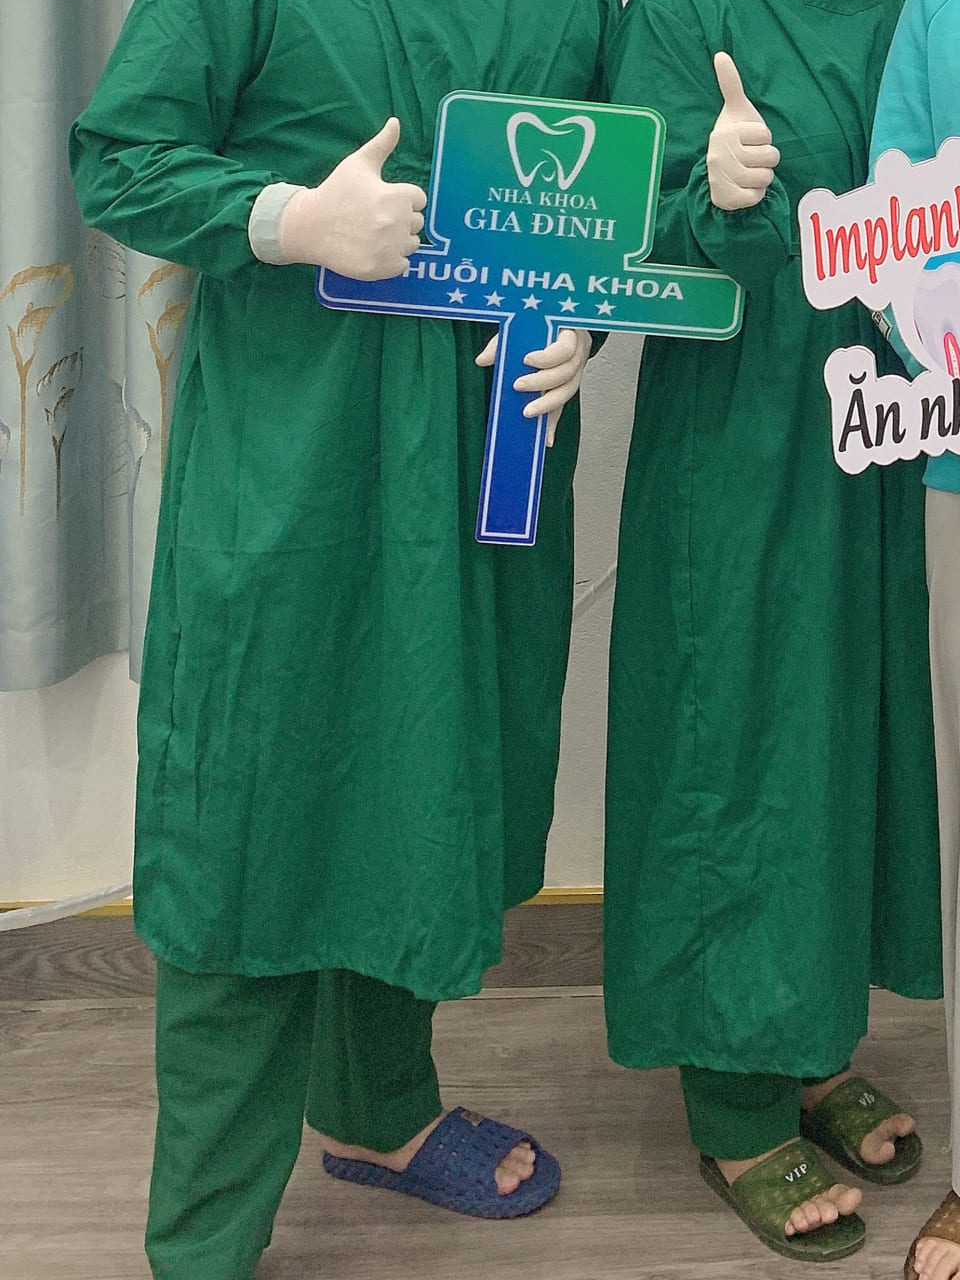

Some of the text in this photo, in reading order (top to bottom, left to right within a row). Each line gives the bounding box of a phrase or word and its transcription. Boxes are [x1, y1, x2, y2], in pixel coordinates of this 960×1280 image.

[488, 187, 598, 210] NHA KHOA
[464, 207, 617, 241] GIA ĐÌNH
[402, 257, 685, 300] HUỖI NHA KHOA
[838, 371, 907, 452] Ăn
[785, 1163, 807, 1182] VIP
